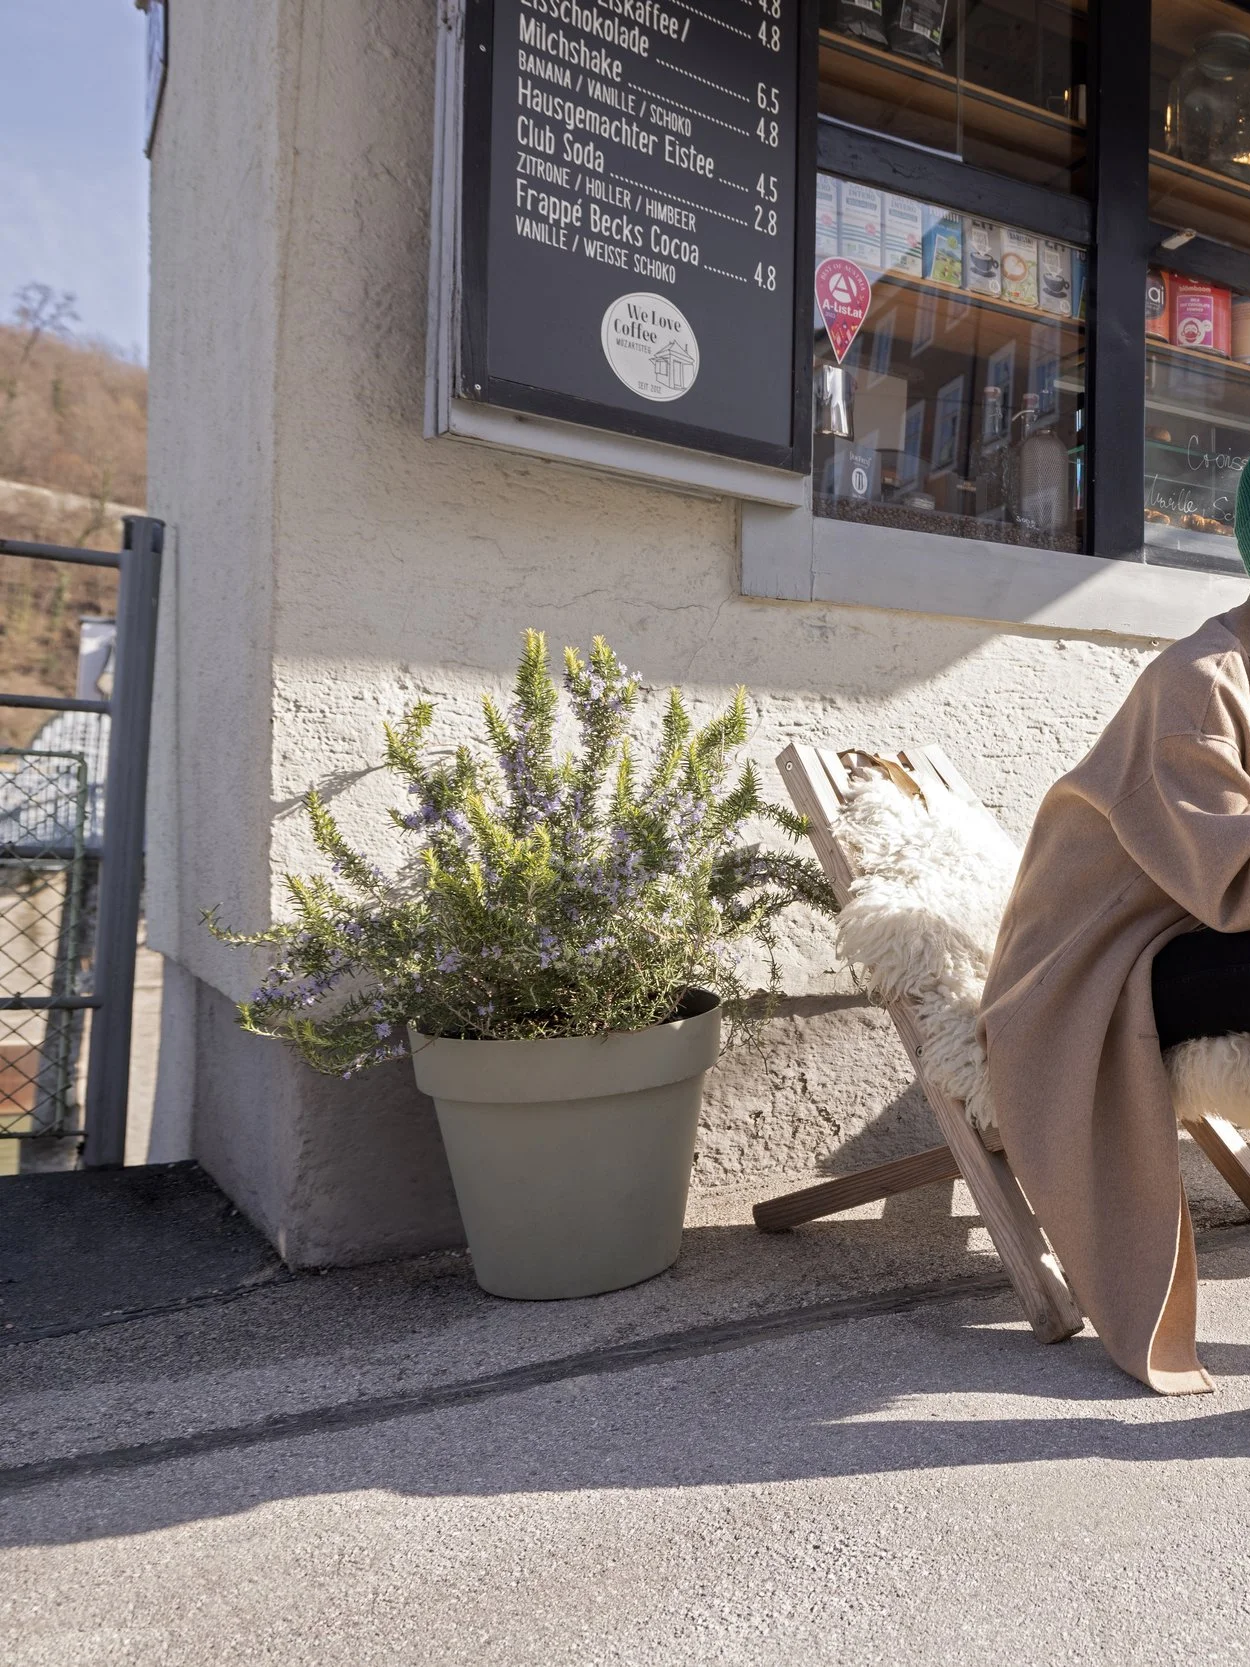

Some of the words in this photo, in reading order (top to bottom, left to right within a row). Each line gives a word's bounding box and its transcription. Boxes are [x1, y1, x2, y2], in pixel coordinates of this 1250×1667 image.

[598, 0, 679, 39] skaffee
[681, 18, 690, 42] /
[758, 20, 780, 52] 4.8
[518, 48, 572, 90] BANANA
[576, 74, 583, 92] /
[588, 77, 636, 116] VANILLE
[640, 100, 646, 118] /
[650, 103, 692, 138] SCHOKO
[519, 12, 622, 82] Milchshake
[756, 117, 779, 148] 4.8
[757, 82, 780, 114] 6.5
[517, 115, 555, 155] Club
[563, 132, 604, 173] Soda
[754, 205, 777, 236] 2.8
[518, 76, 658, 155] Hausgemachter
[665, 134, 714, 178] Eistee
[756, 172, 778, 203] 4.5
[516, 151, 571, 189] ZITRONE
[574, 173, 581, 191] /
[586, 176, 632, 211] HOLLER
[635, 194, 642, 212] /
[645, 197, 696, 233] HIMBEER
[515, 214, 568, 251] VANILLE
[572, 234, 579, 252] /
[583, 237, 629, 270] WEISSE
[633, 253, 676, 284] SCHOKO
[516, 177, 582, 228] Frappé
[590, 203, 644, 248] Becks
[650, 224, 699, 266] Cocoa
[754, 261, 776, 291] 4.8
[614, 317, 657, 344] Coffee
[627, 303, 648, 323] We
[651, 310, 681, 333] Love
